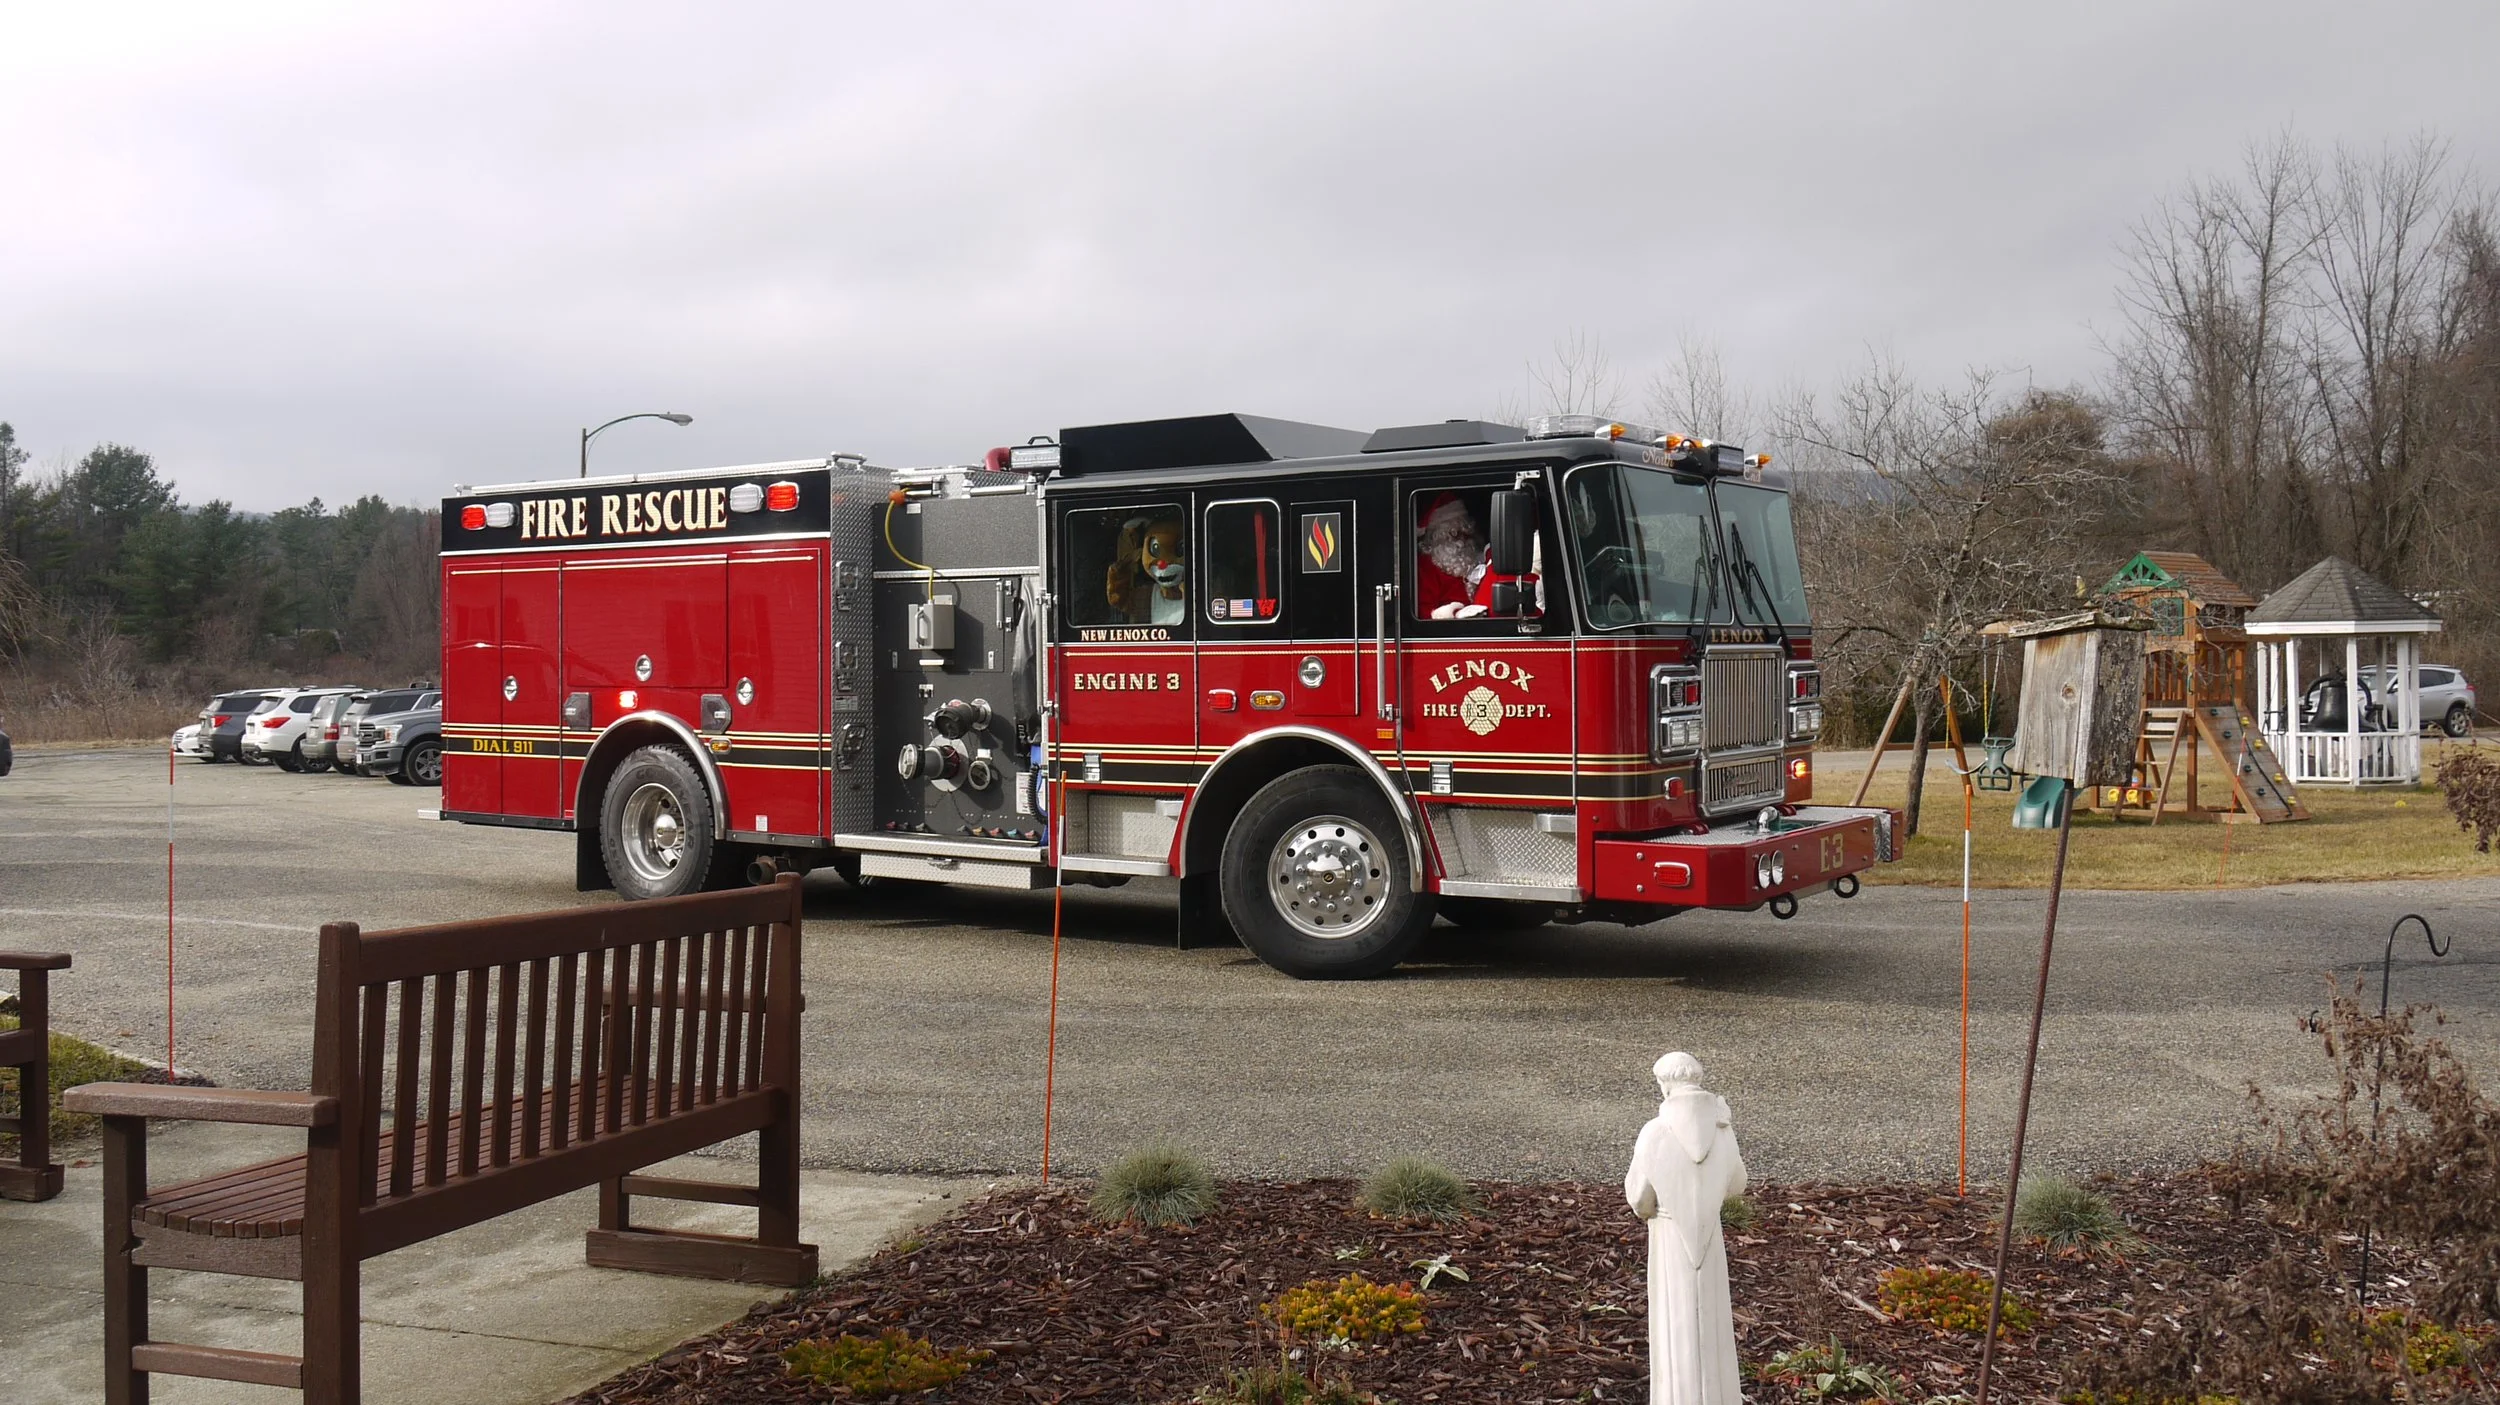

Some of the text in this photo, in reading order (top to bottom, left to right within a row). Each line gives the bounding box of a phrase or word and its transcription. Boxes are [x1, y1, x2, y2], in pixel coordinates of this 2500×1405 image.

[521, 487, 727, 540] FIRE RESCUE
[1081, 628, 1171, 642] NEW LENOX CO.
[1711, 628, 1765, 643] LENOX
[1074, 673, 1181, 691] ENGINE 3
[1429, 659, 1535, 693] LENOX
[1423, 703, 1552, 718] FIRE DEPT.
[1476, 704, 1487, 718] 3
[472, 738, 533, 754] DIAL 911
[1820, 833, 1844, 873] E3
